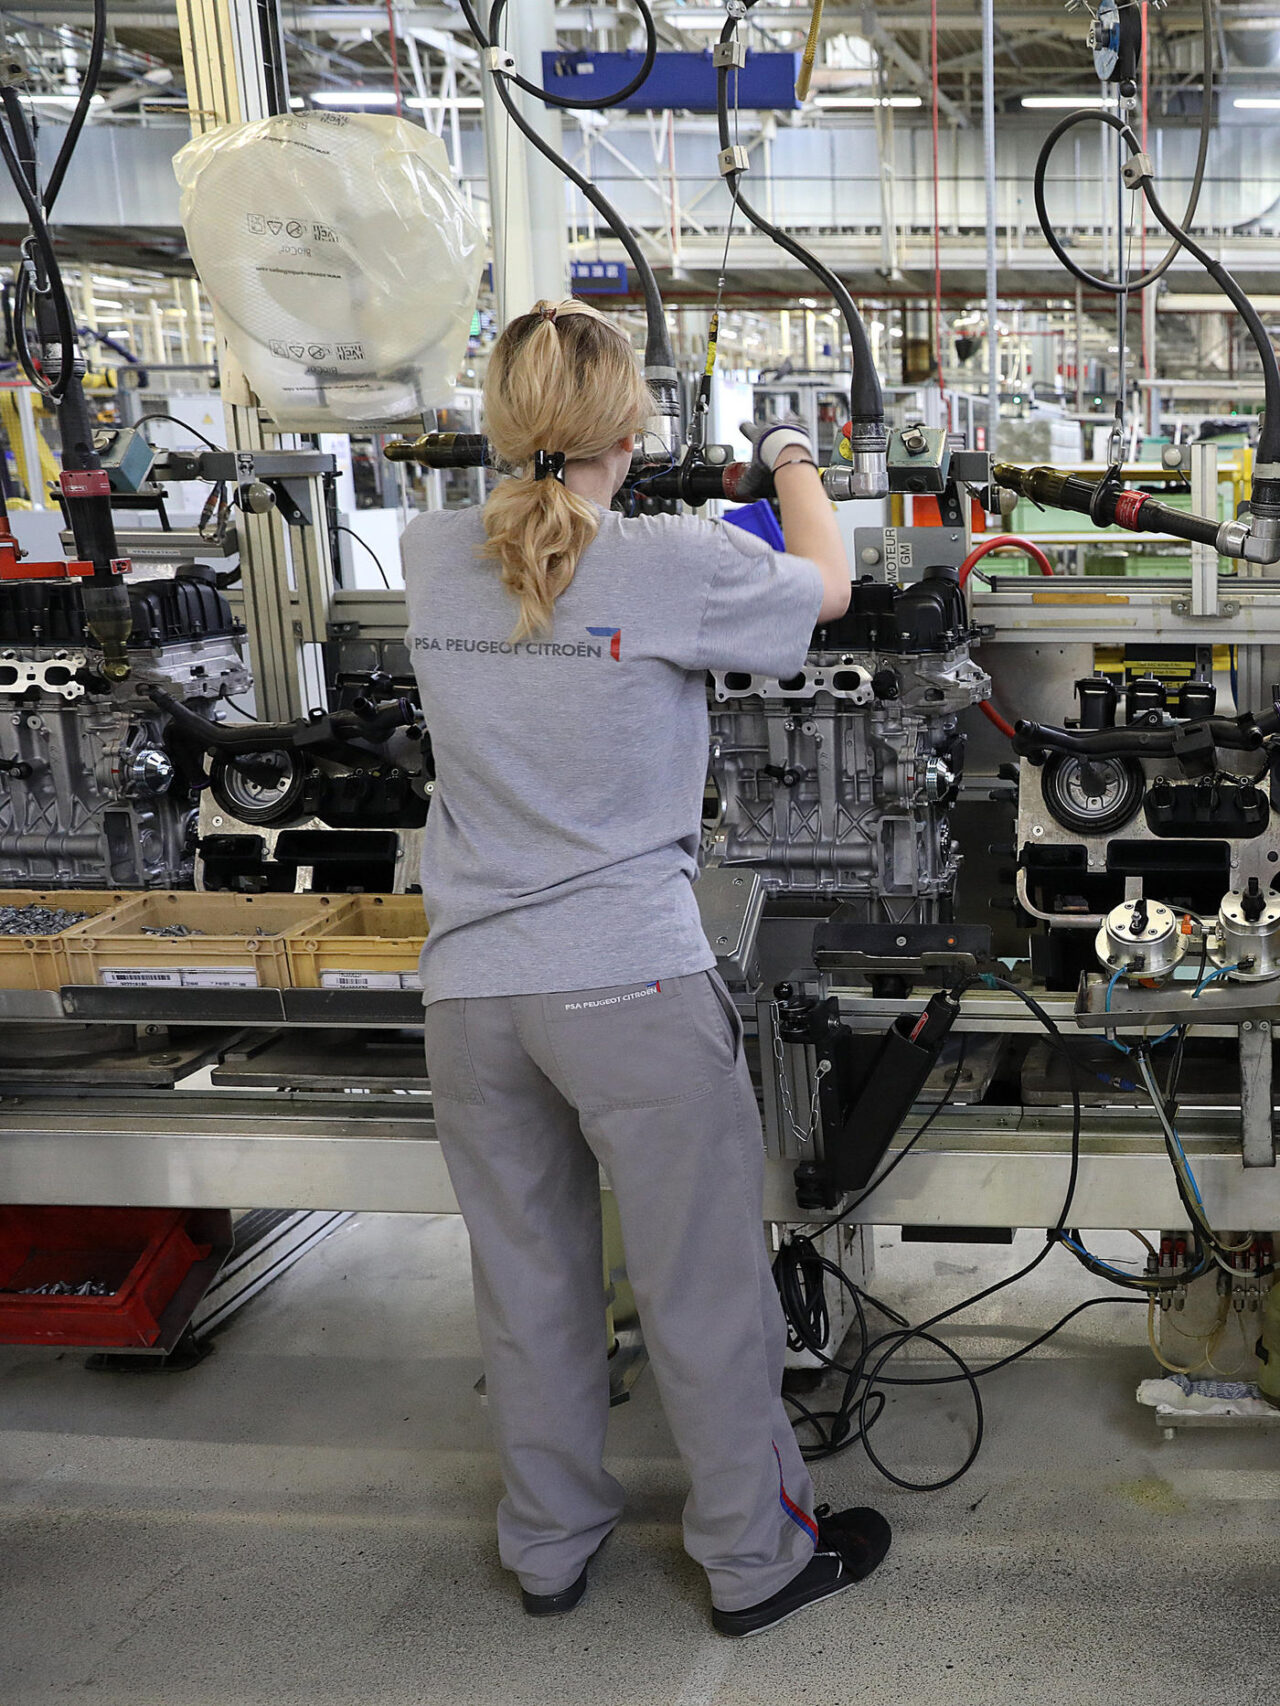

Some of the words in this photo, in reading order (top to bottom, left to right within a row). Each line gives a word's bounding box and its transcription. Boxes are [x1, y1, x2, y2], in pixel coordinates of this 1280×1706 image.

[884, 528, 897, 582] MOTEUR
[900, 544, 911, 565] GM
[415, 637, 442, 651] PSA
[446, 638, 524, 656] PEUGEOT
[525, 641, 602, 658] CITROËN
[564, 1003, 582, 1011] PSA
[583, 996, 621, 1009] PEUGEOT
[622, 986, 657, 1001] CITROËN
